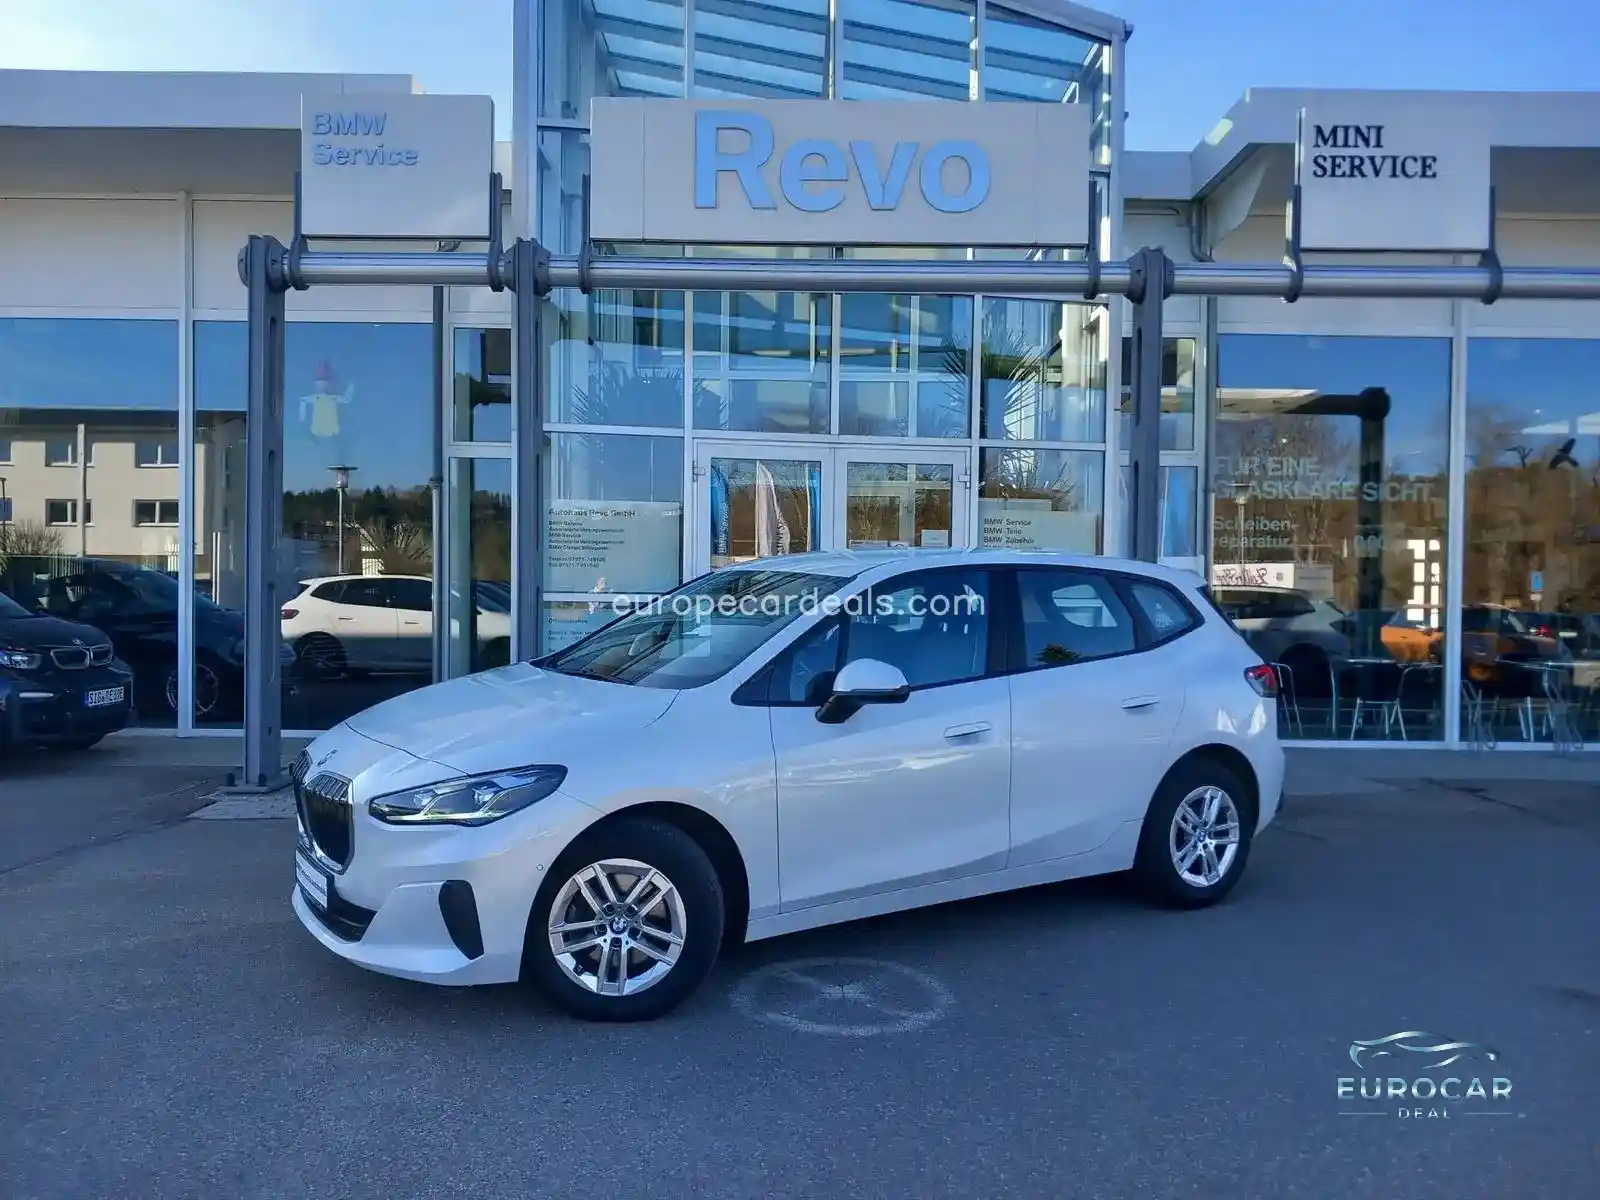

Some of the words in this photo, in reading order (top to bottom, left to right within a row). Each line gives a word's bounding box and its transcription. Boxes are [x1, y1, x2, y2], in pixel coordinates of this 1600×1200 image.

[312, 111, 388, 136] BMW
[1312, 124, 1385, 148] MINI
[314, 143, 420, 166] Service
[693, 110, 993, 213] Revo
[1312, 154, 1438, 178] SERVICE
[984, 517, 1003, 525] BMW
[1006, 518, 1032, 526] Service
